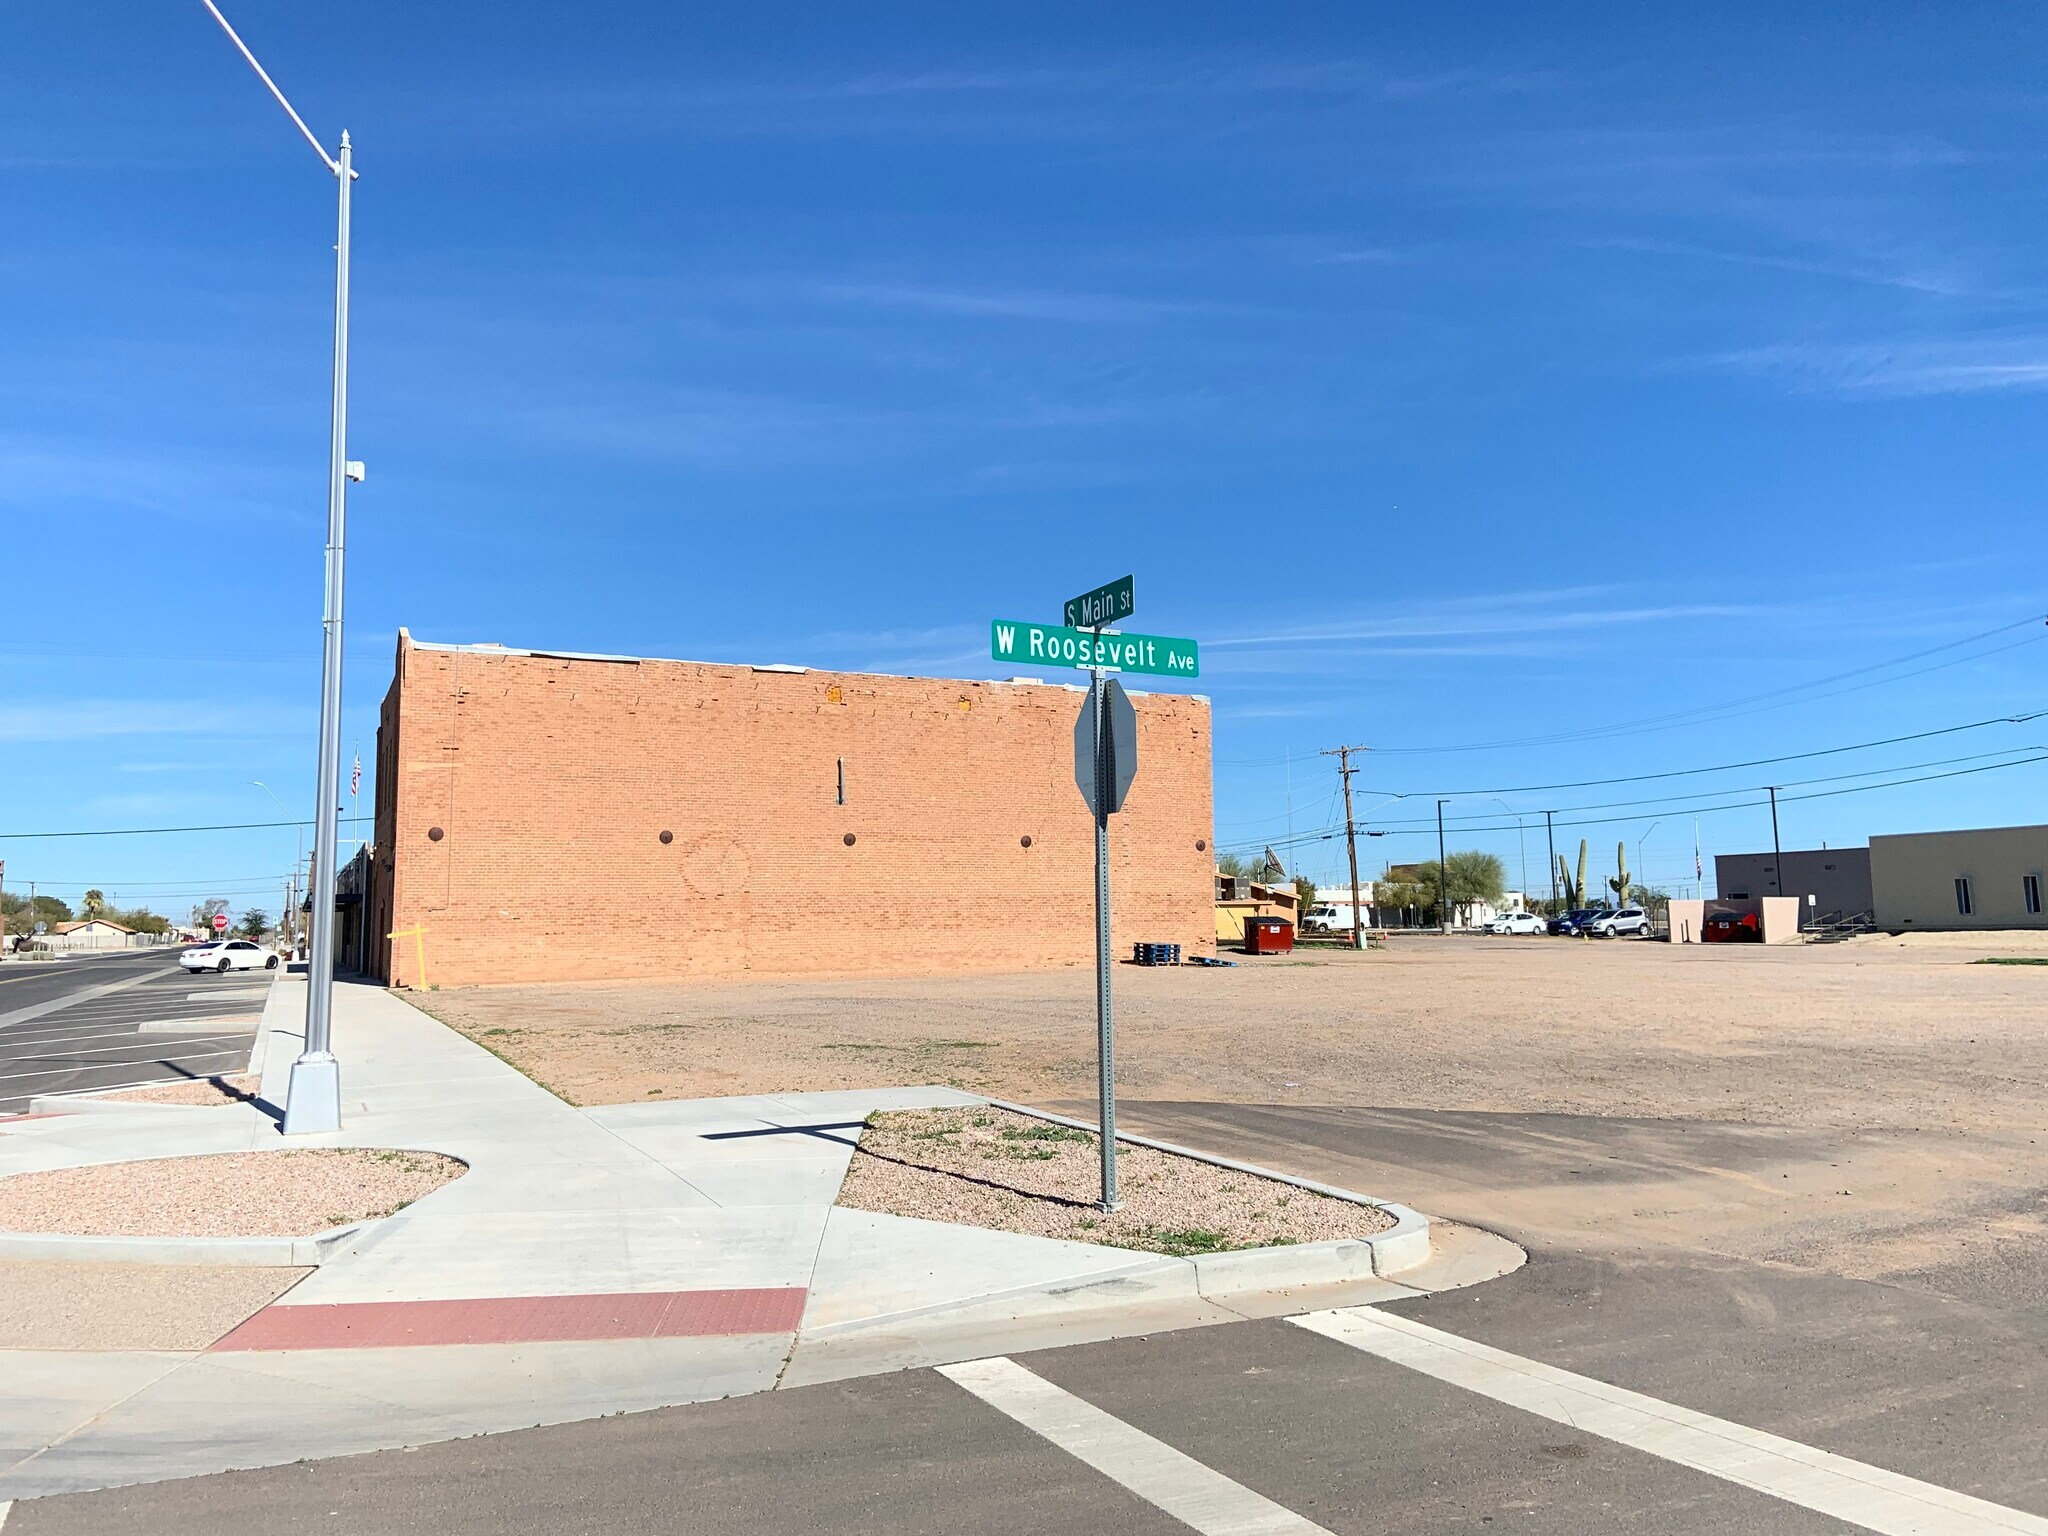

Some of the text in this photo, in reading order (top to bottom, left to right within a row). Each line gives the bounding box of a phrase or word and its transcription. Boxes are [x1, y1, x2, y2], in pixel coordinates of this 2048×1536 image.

[1067, 589, 1131, 628] S Main St
[996, 625, 1194, 670] W Roosevelt Ave
